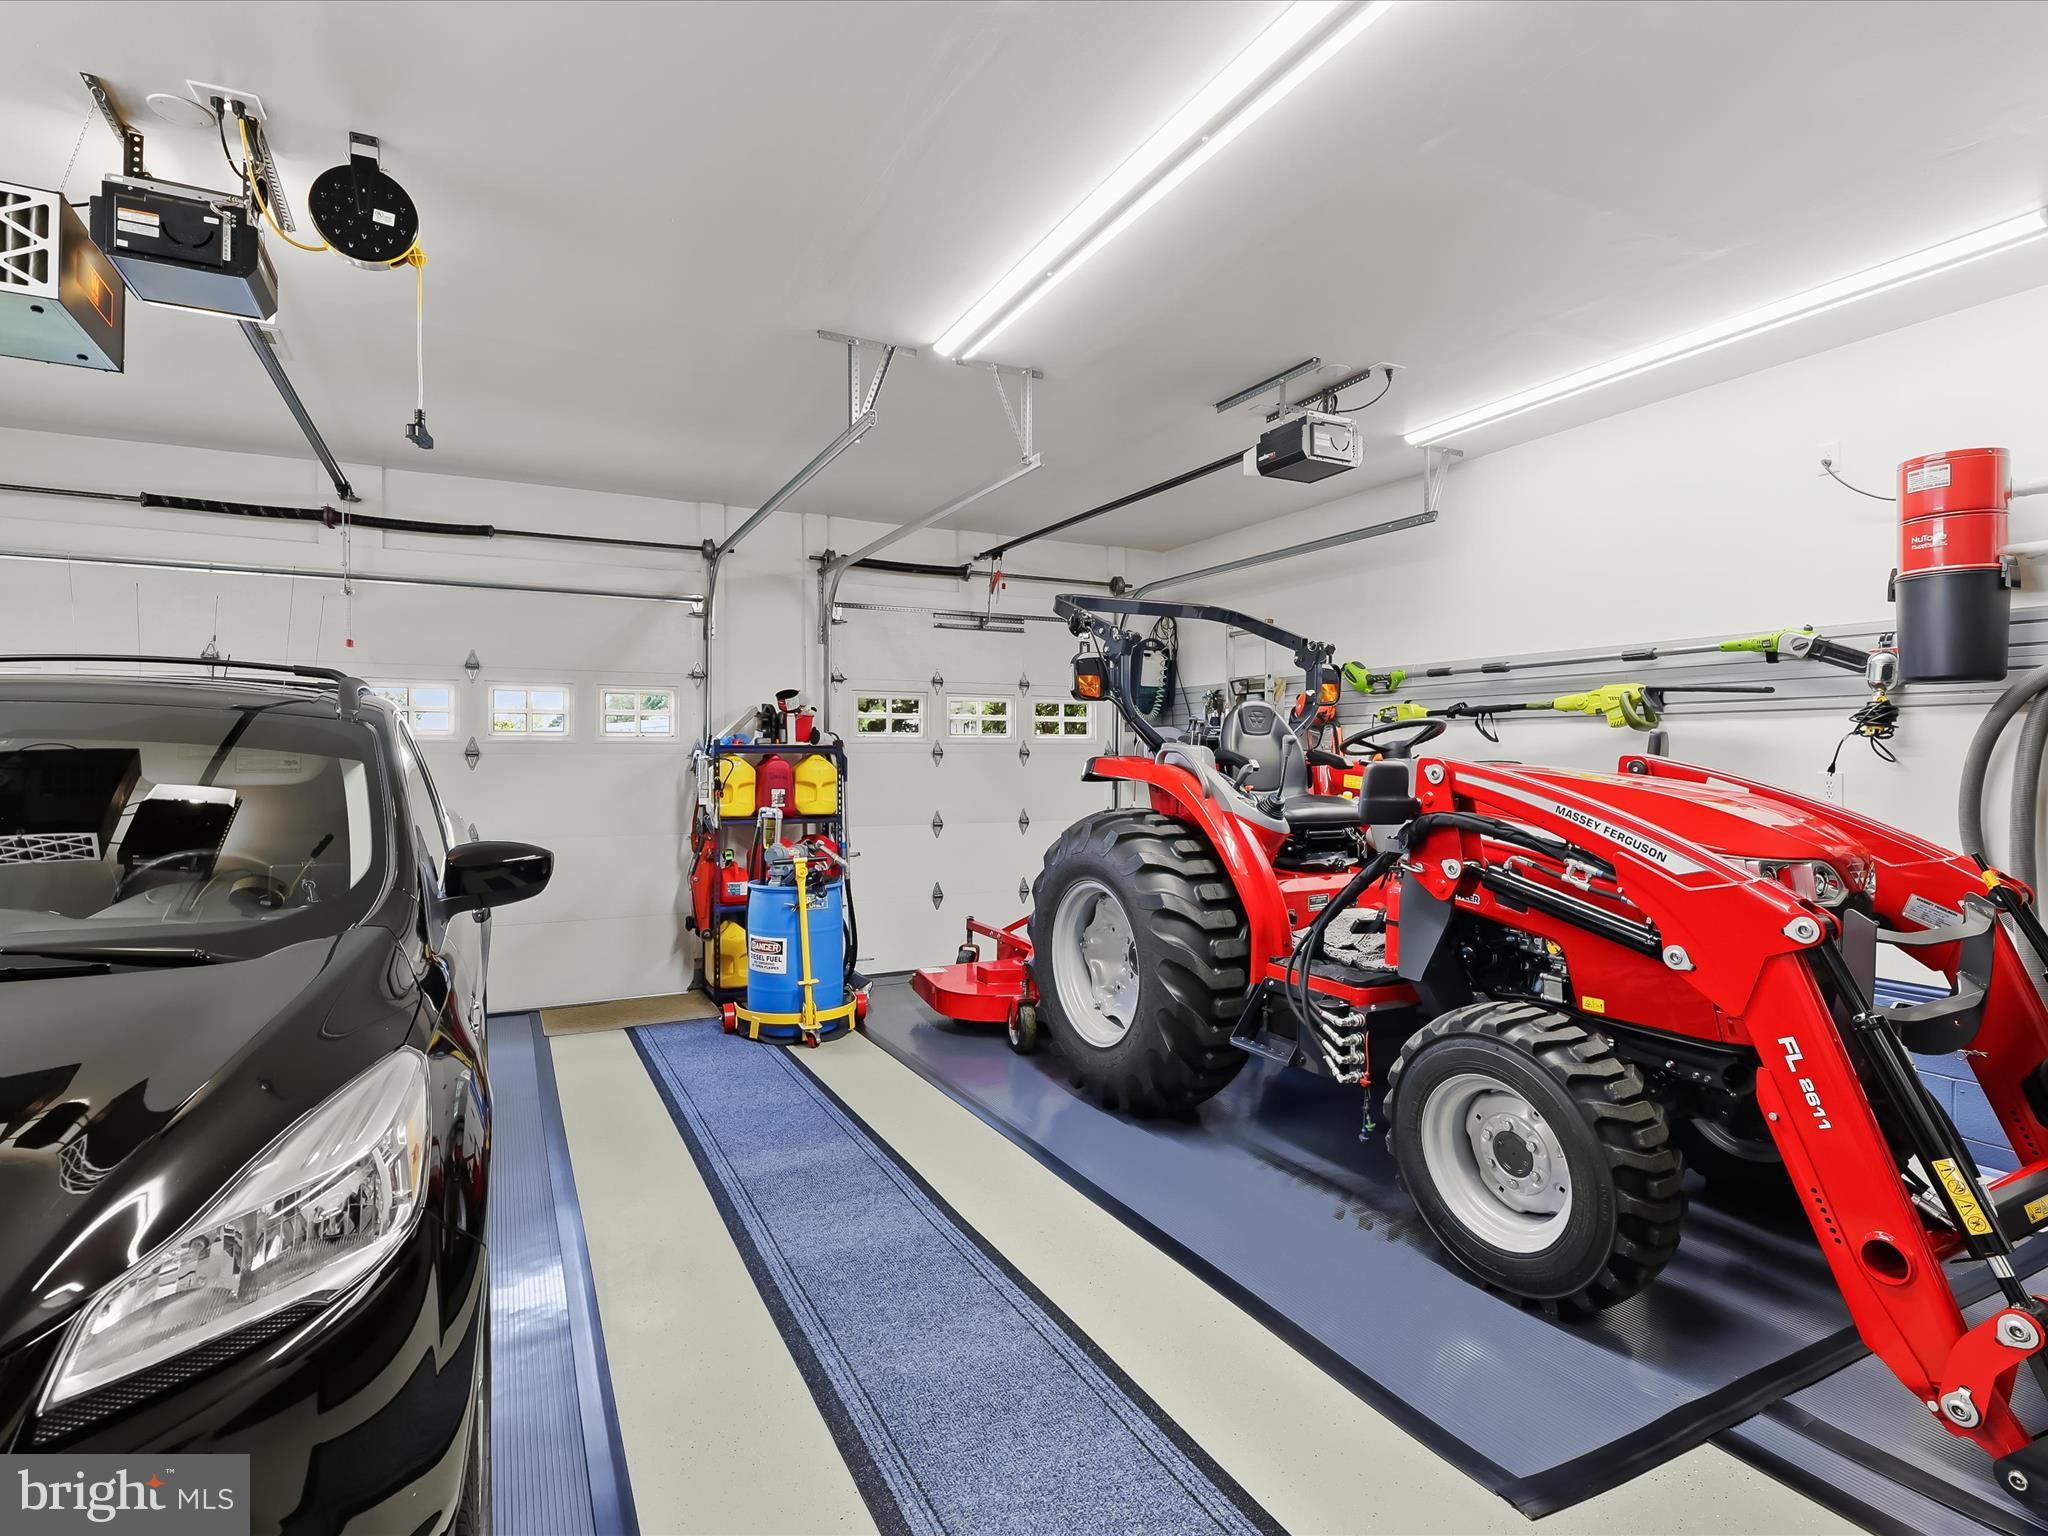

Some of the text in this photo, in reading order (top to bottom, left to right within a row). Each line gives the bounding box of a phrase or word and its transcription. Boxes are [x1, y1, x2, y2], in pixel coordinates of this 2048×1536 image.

[1911, 533, 1947, 544] NuToe
[1555, 805, 1667, 862] MASSEY FERGUSON
[752, 941, 779, 952] DANGER
[766, 955, 782, 963] FUEL
[1777, 1035, 1804, 1073] FL
[1798, 1077, 1832, 1130] 2611
